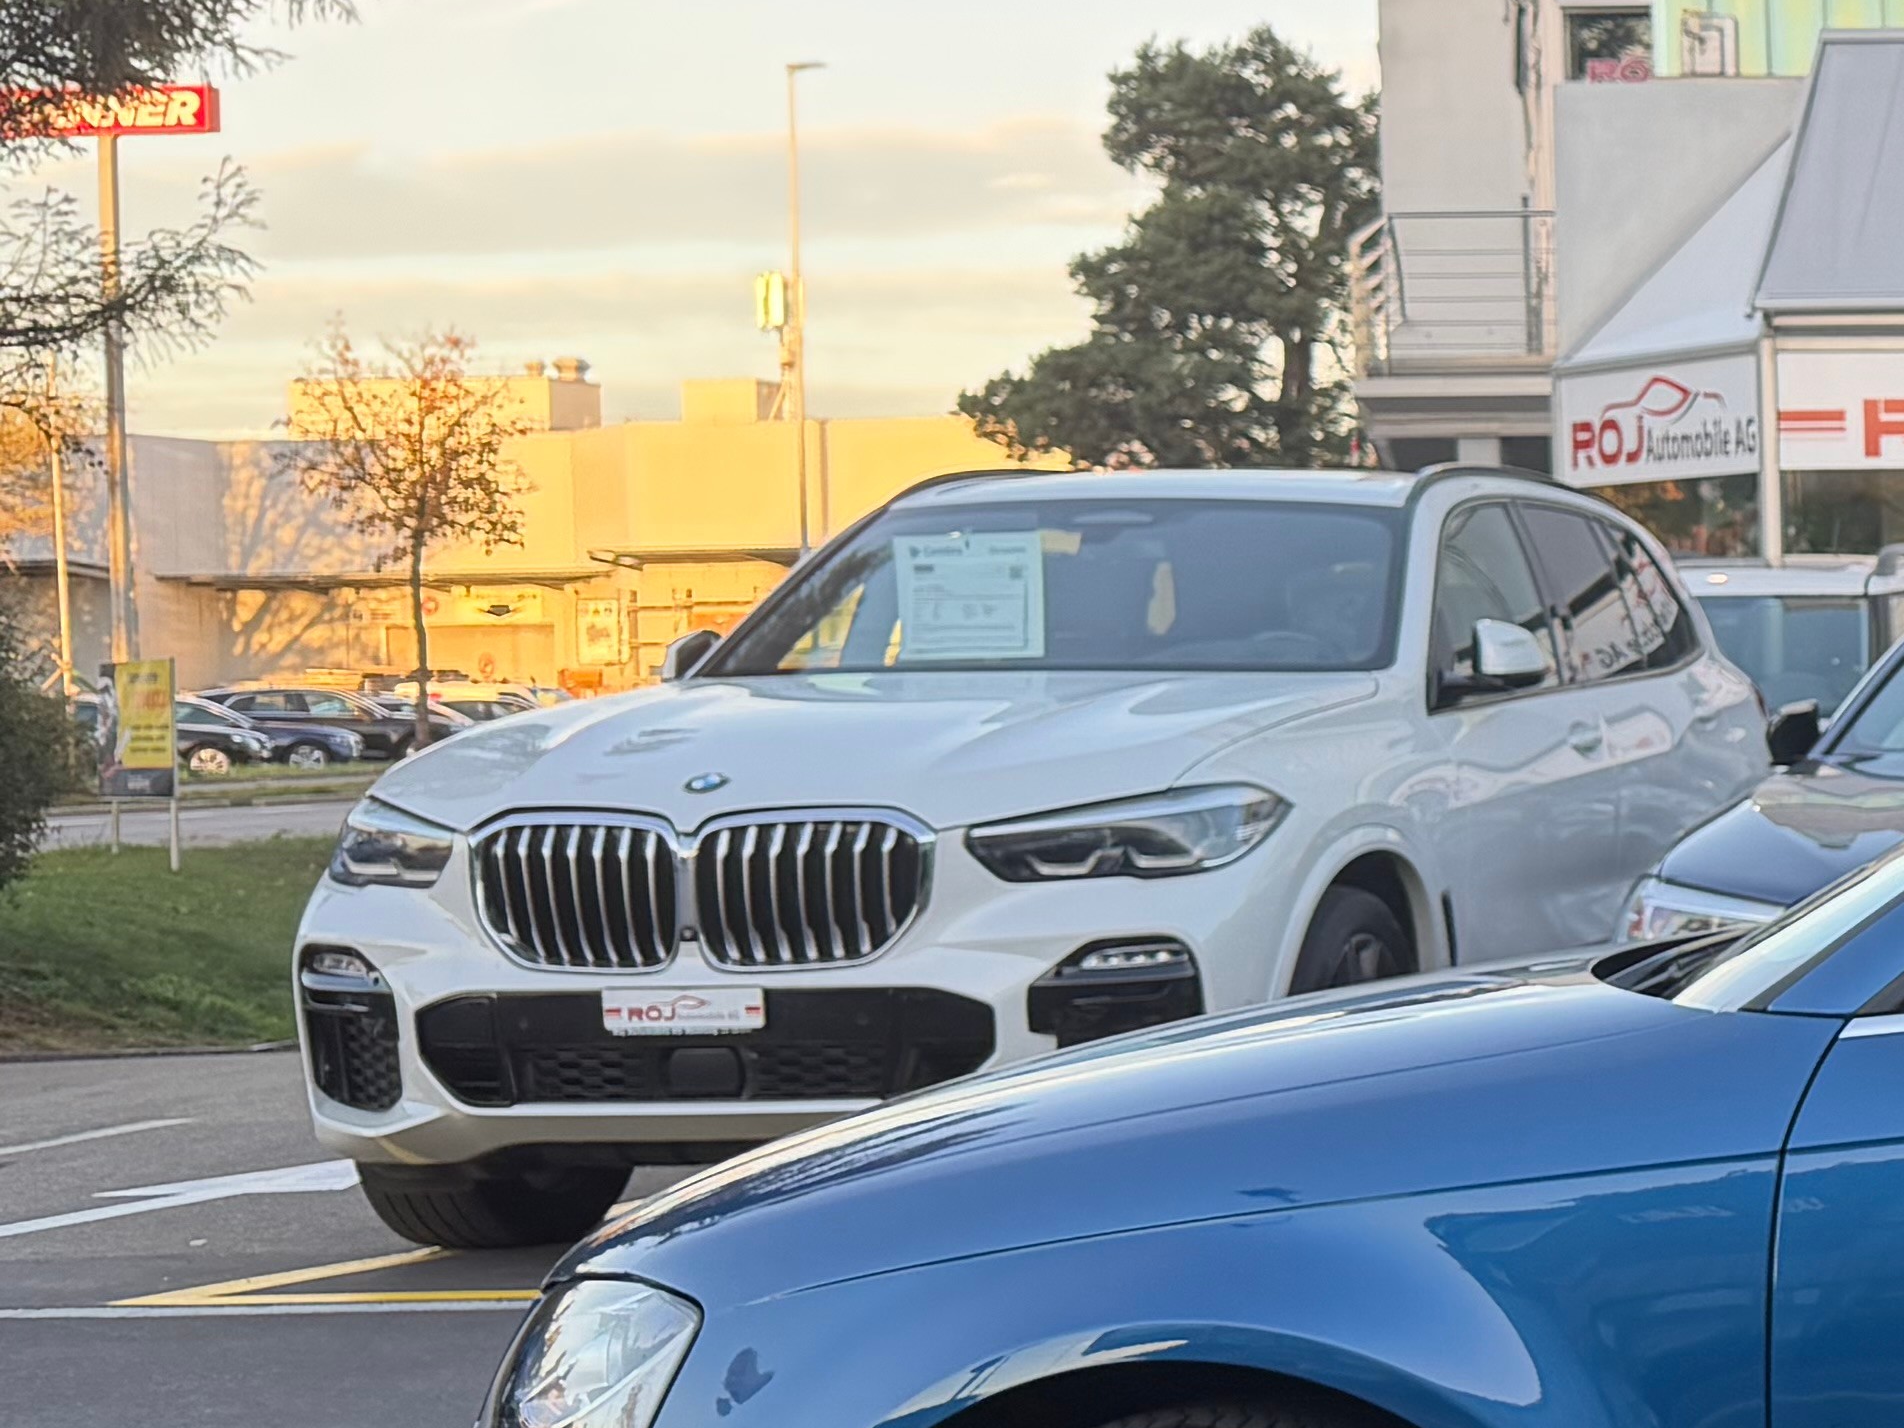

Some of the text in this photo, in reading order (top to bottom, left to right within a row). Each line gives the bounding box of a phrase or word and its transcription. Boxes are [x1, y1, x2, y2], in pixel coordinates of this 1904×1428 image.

[1571, 414, 1758, 470] ROJ Automobile AG
[627, 1004, 676, 1021] ROJ
